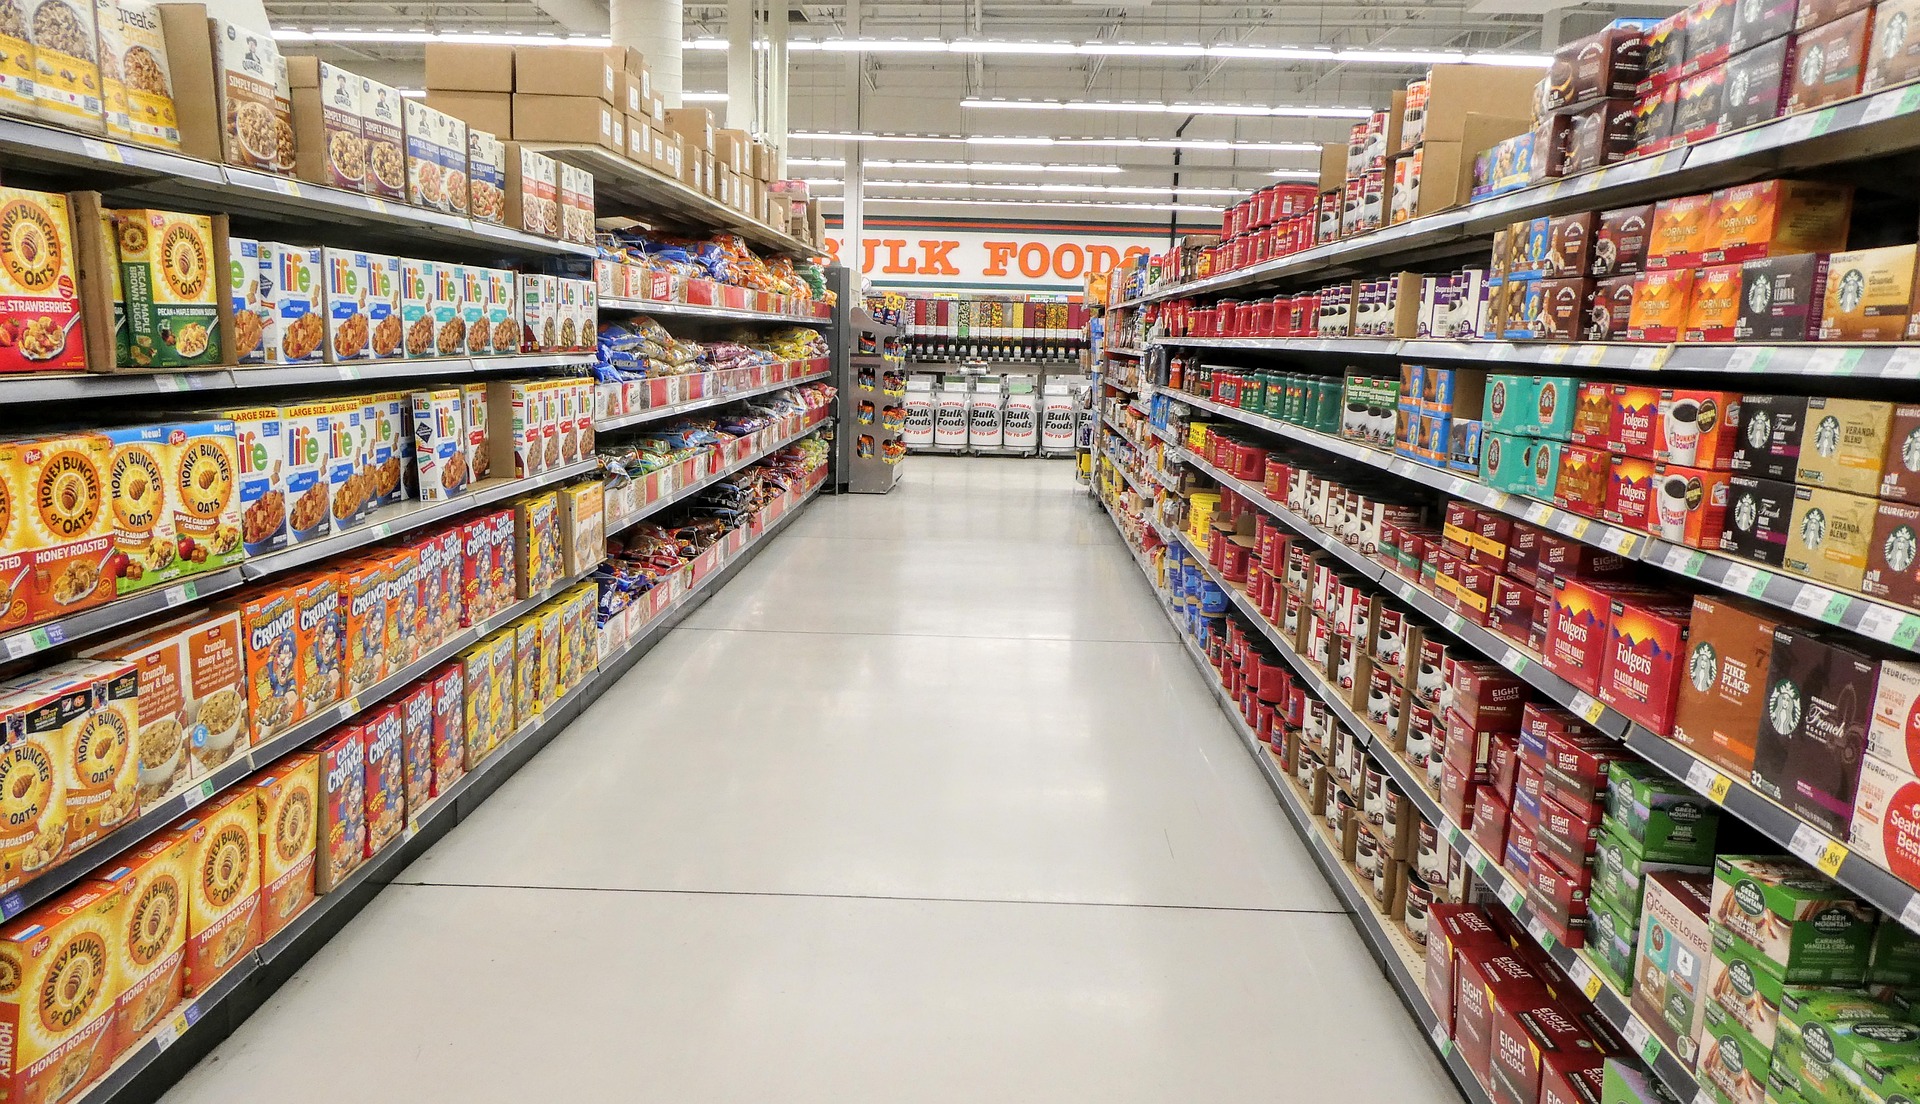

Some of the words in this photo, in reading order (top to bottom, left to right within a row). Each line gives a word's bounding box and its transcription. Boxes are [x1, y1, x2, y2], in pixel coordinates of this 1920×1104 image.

[1617, 38, 1640, 53] DONUT
[24, 262, 55, 286] OATS
[137, 265, 146, 294] PECAN
[279, 252, 311, 292] life
[330, 257, 358, 295] life
[368, 261, 390, 297] life
[129, 267, 139, 301] BROWN
[180, 275, 202, 295] OATS
[403, 267, 425, 299] life
[436, 270, 456, 301] life
[463, 272, 482, 302] life
[489, 276, 506, 303] life
[8, 300, 73, 313] STRAWBERRIES
[133, 303, 142, 331] SUGAR
[141, 304, 150, 333] MAPLE
[290, 408, 311, 417] LARGE
[313, 406, 327, 414] SIZE
[414, 399, 430, 410] life
[907, 409, 929, 417] Bulk
[939, 409, 963, 418] Bulk
[972, 410, 995, 419] Bulk
[231, 411, 258, 421] LARGE
[258, 410, 276, 418] SIZE
[436, 407, 455, 438] life
[904, 418, 932, 426] Foods
[937, 418, 965, 427] Foods
[970, 418, 998, 427] Foods
[1005, 419, 1032, 428] Foods
[1007, 411, 1030, 420] Bulk
[1045, 420, 1073, 430] Foods
[1047, 412, 1071, 421] Bulk
[1623, 413, 1649, 429] Folgers
[141, 428, 162, 439] New!
[170, 432, 186, 442] Post
[214, 423, 233, 433] New!
[1845, 426, 1875, 437] VERANDA
[289, 426, 319, 466] life
[329, 421, 352, 459] life
[1676, 441, 1696, 449] DONUTS
[1844, 436, 1862, 444] BLEND
[25, 452, 42, 462] Post
[182, 449, 197, 488] HONEY
[200, 445, 229, 481] BUNCHES
[42, 460, 61, 508] HONEY
[63, 457, 97, 500] BUNCHES
[129, 452, 160, 492] BUNCHES
[1620, 484, 1646, 500] Folgers
[197, 500, 220, 513] OATS
[63, 508, 93, 534] OATS
[129, 511, 153, 525] OATS
[175, 514, 191, 522] APPLE
[1666, 517, 1683, 525] DONUTS
[1831, 520, 1860, 534] VERANDA
[467, 528, 491, 556] CRUNCH
[491, 520, 514, 546] CRUNCH
[1829, 530, 1847, 540] BLEND
[36, 547, 70, 564] HONEY
[70, 540, 108, 560] ROASTED
[387, 567, 418, 600] CRUNCH
[352, 581, 387, 617] CRUNCH
[1693, 600, 1713, 614] KEURIG
[300, 592, 338, 631] CRUNCH
[252, 608, 295, 651] CRUNCH
[1558, 614, 1587, 643] Folgers
[204, 639, 226, 654] Crunchy
[1555, 638, 1571, 653] CLASSIC
[1572, 644, 1584, 661] ROAST
[1617, 643, 1651, 673] Folgers
[142, 665, 166, 681] Crunchy
[1614, 669, 1633, 687] CLASSIC
[1633, 677, 1649, 694] ROAST
[1724, 662, 1746, 680] PIKE
[1492, 687, 1519, 696] EIGHT
[1722, 673, 1750, 694] PLACE
[1493, 694, 1519, 702] O'CLOCK
[1532, 720, 1547, 730] EIGHT
[1674, 725, 1683, 738] 32
[1806, 704, 1846, 738] French
[78, 720, 96, 763] HONEY
[98, 714, 126, 745] BUNCHES
[369, 719, 402, 764] CRUNCH
[328, 743, 364, 793] CRUNCH
[1558, 763, 1578, 772] O'CLOCK
[1559, 752, 1578, 764] EIGHT
[92, 767, 115, 784] OATS
[1526, 777, 1539, 787] EIGHT
[1751, 770, 1762, 786] 32
[1706, 778, 1725, 796] 18.88
[10, 804, 38, 825] OATS
[1551, 815, 1569, 828] EIGHT
[1518, 835, 1533, 846] EIGHT
[1815, 844, 1840, 867] 18.88
[272, 872, 290, 893] HONEY
[290, 856, 312, 881] ROASTED
[1539, 873, 1556, 886] EIGHT
[222, 871, 244, 902] OATS
[1740, 885, 1760, 901] GREEN
[1735, 890, 1762, 911] MOUNTAIN
[132, 892, 151, 943] HONEY
[201, 920, 226, 944] HONEY
[227, 895, 254, 925] ROASTED
[1464, 912, 1492, 932] EIGHT
[1653, 900, 1679, 927] COFFEE
[1679, 920, 1707, 952] LOVERS
[146, 925, 170, 960] OATS
[44, 952, 68, 1010] HONEY
[70, 940, 101, 977] BUNCHES
[1500, 956, 1533, 979] EIGHT
[122, 981, 150, 1005] HONEY
[151, 952, 179, 986] ROASTED
[1462, 976, 1483, 1000] EIGHT
[62, 987, 95, 1027] OATS
[1463, 997, 1483, 1018] O'CLOCK
[1532, 1009, 1564, 1033] O'CLOCK
[1539, 1007, 1577, 1032] EIGHT
[30, 1048, 64, 1078] HONEY
[66, 1015, 106, 1052] ROASTED
[1500, 1030, 1526, 1057] EIGHT
[1803, 1034, 1833, 1060] MOUNTAIN
[1808, 1027, 1828, 1046] GREEN
[1501, 1049, 1526, 1076] O'CLOCK
